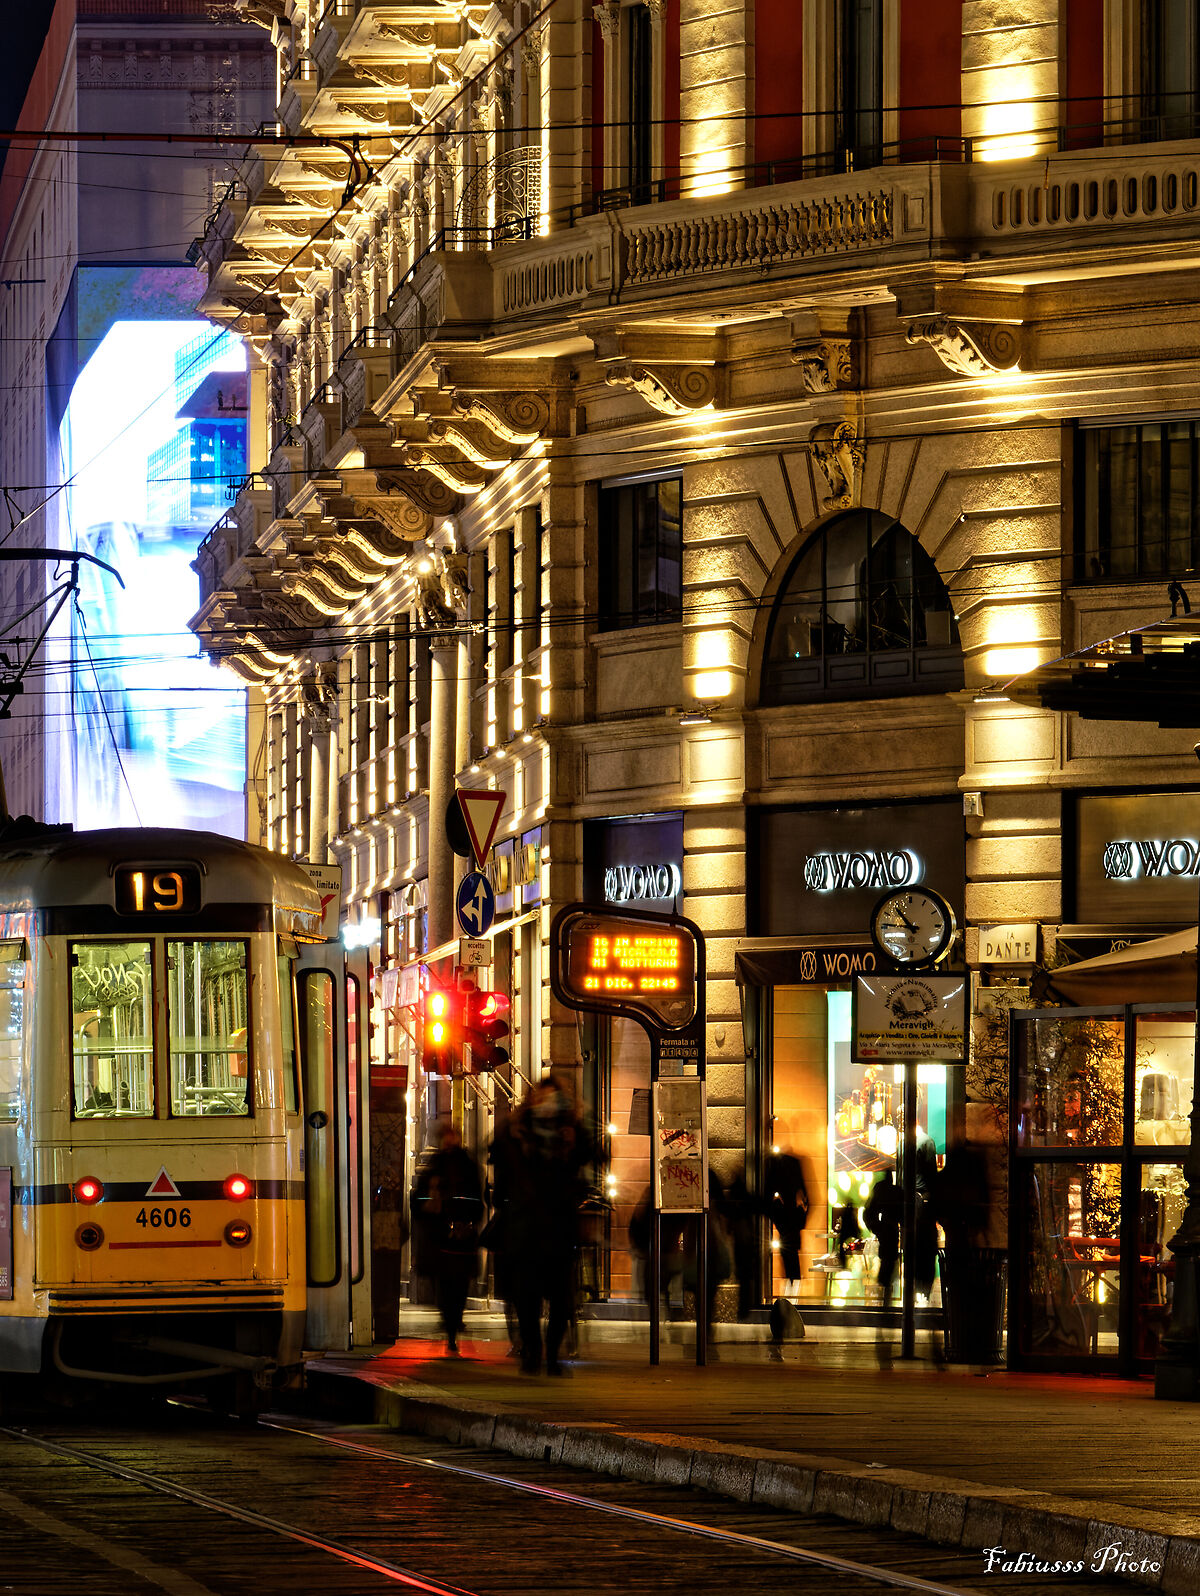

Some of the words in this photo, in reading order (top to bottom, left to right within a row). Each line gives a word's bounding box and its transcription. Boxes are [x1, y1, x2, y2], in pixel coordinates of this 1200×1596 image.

[1136, 840, 1200, 877] WO
[309, 869, 322, 877] zona
[823, 850, 914, 889] WOMO
[619, 864, 671, 899] WOMO
[133, 872, 184, 911] 19
[467, 941, 485, 950] eccetto
[593, 937, 609, 947] 16
[615, 937, 630, 947] IN
[986, 941, 1031, 959] DANTE
[593, 946, 609, 957] 19
[822, 951, 877, 977] WOMO
[585, 977, 599, 989] 21
[605, 977, 635, 989] DIC.
[640, 977, 678, 989] 22:45
[660, 1038, 688, 1046] Fermata
[136, 1207, 192, 1228] 4606
